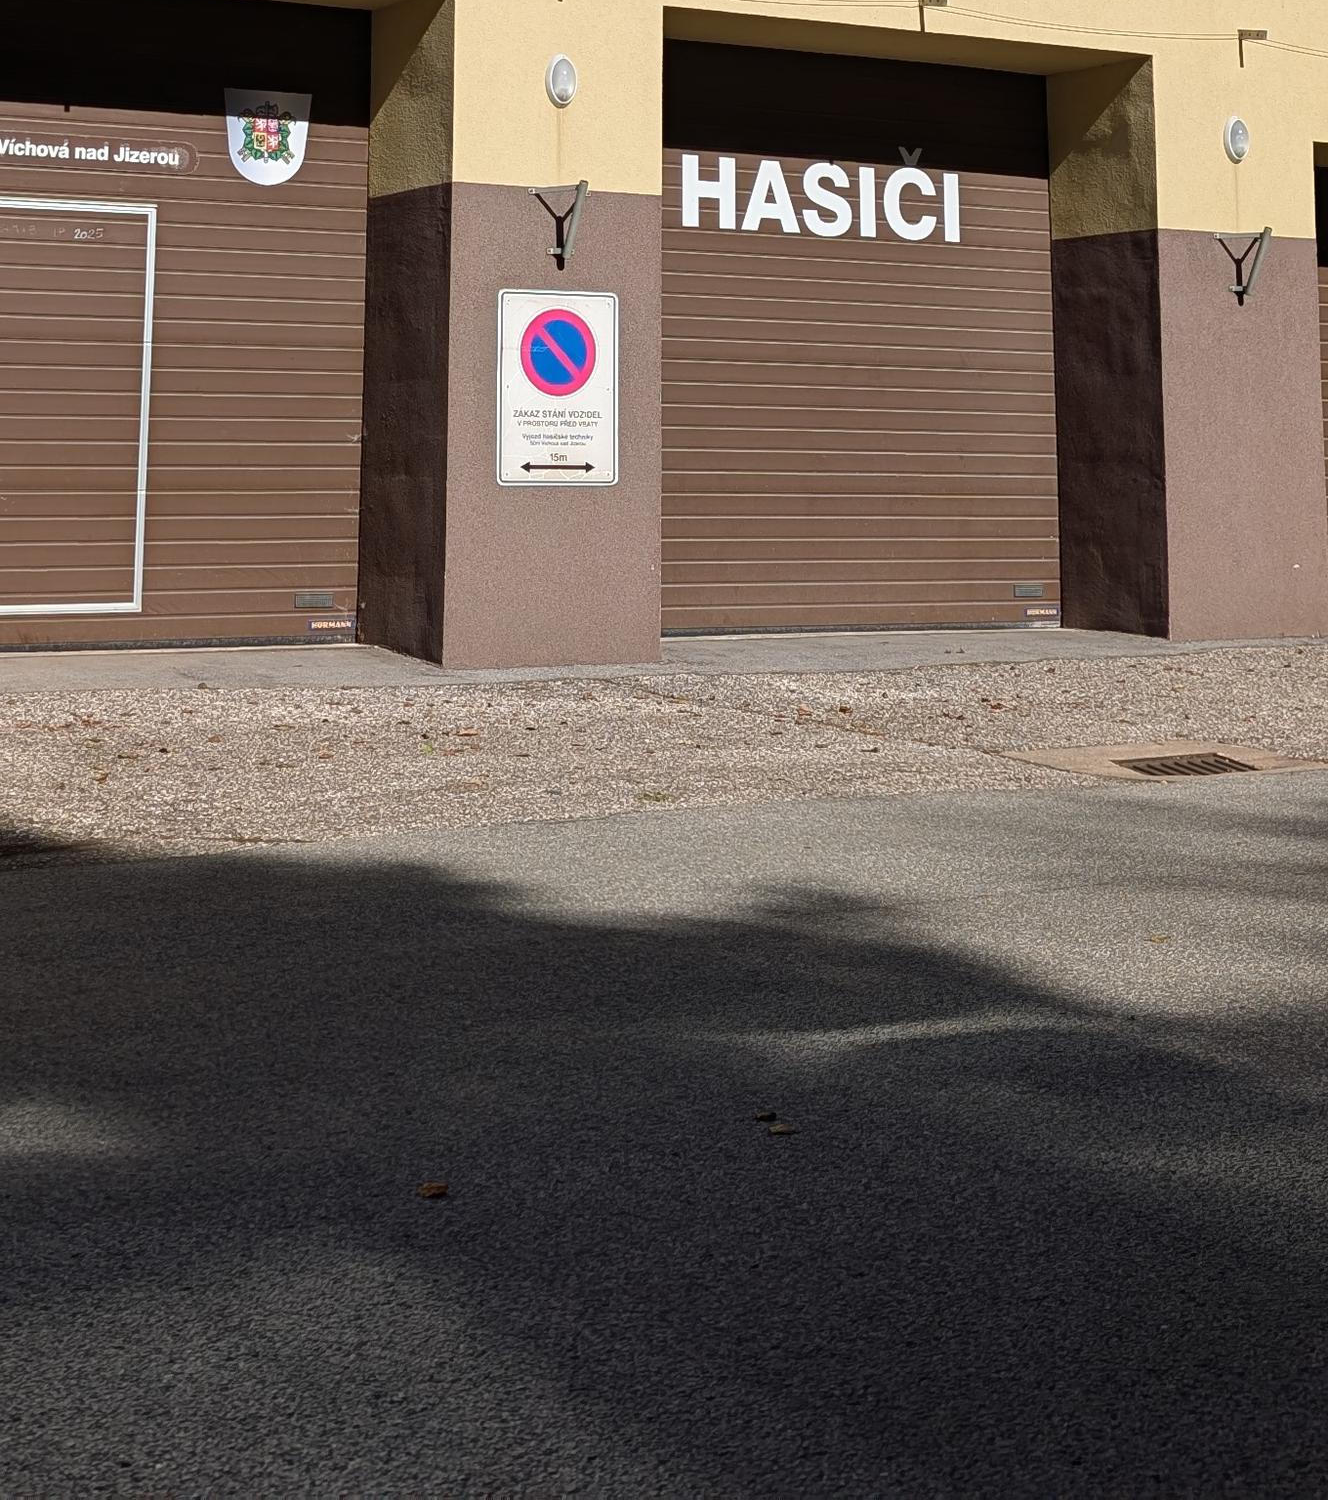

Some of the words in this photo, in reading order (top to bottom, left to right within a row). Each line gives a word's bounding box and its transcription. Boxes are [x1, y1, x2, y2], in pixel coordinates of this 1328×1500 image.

[75, 145, 109, 161] nad
[113, 146, 180, 166] Jizerou
[681, 146, 961, 243] HASIČI
[74, 228, 104, 239] 2025
[513, 407, 540, 418] ZÁKAZ
[542, 408, 566, 419] STÁNÍ
[568, 410, 603, 419] VOZIDEL
[550, 453, 568, 462] 15m
